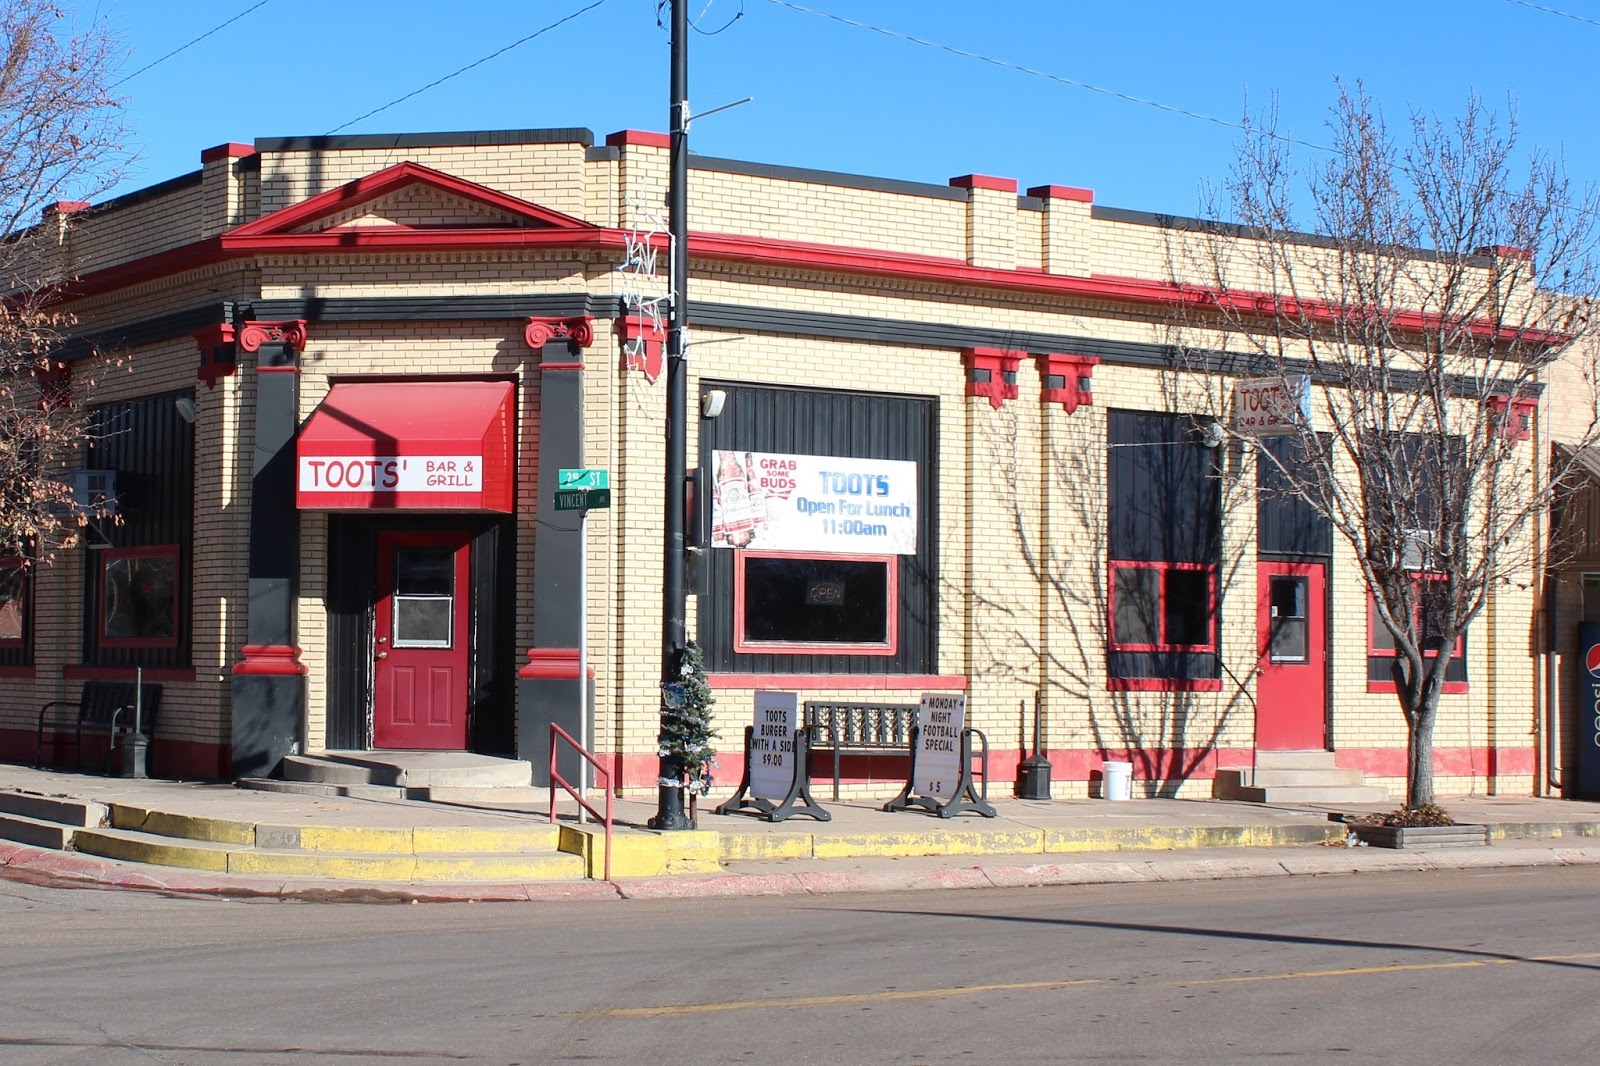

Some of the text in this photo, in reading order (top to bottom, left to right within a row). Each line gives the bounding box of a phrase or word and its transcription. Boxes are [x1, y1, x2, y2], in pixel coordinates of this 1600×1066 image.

[426, 460, 474, 473] BAR &
[760, 459, 797, 471] GRAB
[308, 460, 407, 488] TOOTS'
[427, 474, 473, 487] GRILL
[590, 472, 601, 486] ST
[766, 470, 790, 478] SOME
[760, 477, 797, 489] BUDS
[819, 471, 890, 497] TOOTS
[560, 494, 587, 508] VINCENT
[797, 497, 911, 518] Open For Lunch
[823, 519, 888, 536] 11:00am
[810, 587, 842, 599] OPEN
[928, 697, 958, 710] MONDAY
[765, 709, 787, 723] TOOTS
[931, 711, 952, 724] NIGHT
[760, 724, 787, 737] BURGER
[923, 724, 958, 738] FOOTBALL
[752, 738, 770, 751] WITH
[772, 739, 777, 751] A
[925, 739, 954, 752] SPECIAL
[763, 753, 783, 767] $9.00
